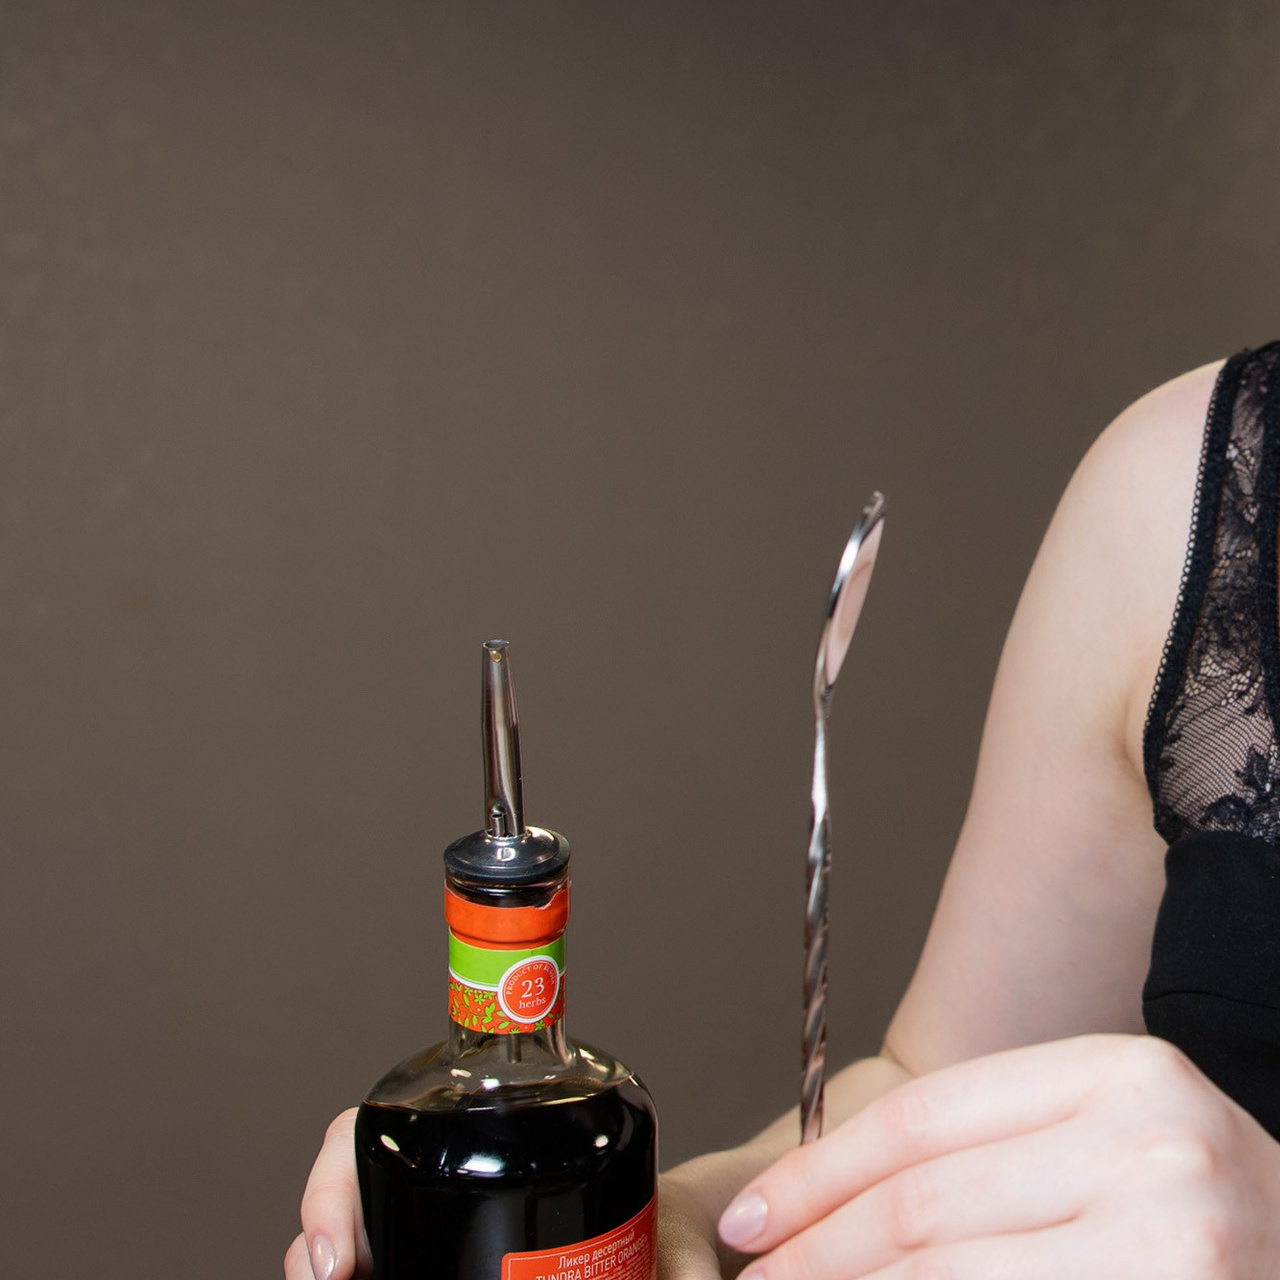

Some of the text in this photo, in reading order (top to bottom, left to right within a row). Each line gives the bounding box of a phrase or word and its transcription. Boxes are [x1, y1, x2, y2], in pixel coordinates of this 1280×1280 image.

[506, 966, 532, 995] PRODUCT
[521, 977, 545, 999] 23
[519, 997, 547, 1009] herbs
[558, 1229, 635, 1270] Ликер десертный
[584, 1255, 617, 1279] BITTER
